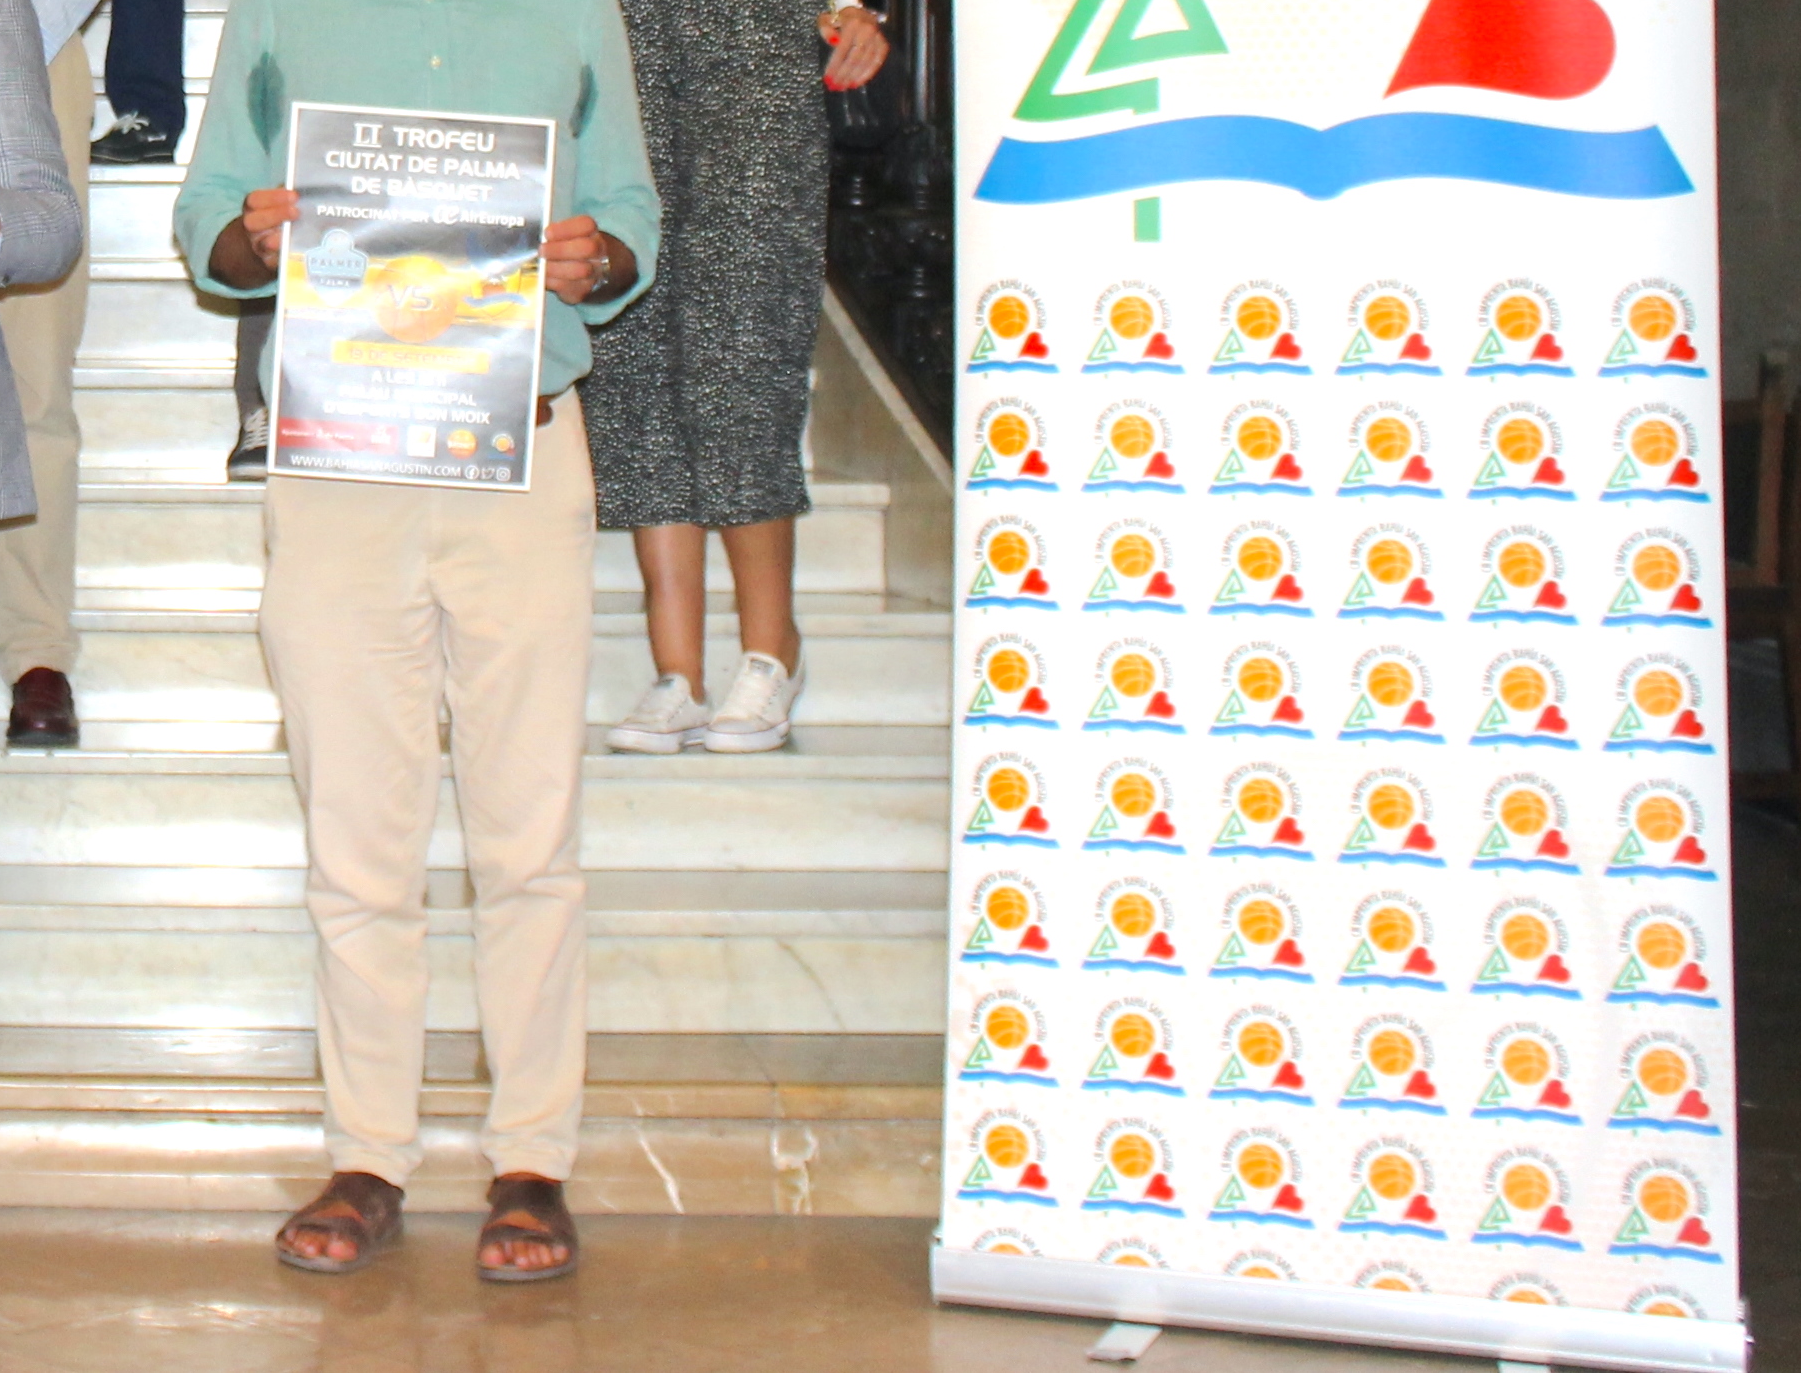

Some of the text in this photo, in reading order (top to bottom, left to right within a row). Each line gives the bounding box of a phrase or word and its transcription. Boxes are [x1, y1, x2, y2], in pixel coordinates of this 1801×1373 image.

[391, 125, 496, 153] TROFEU
[324, 148, 521, 181] CIUTAT DE PALMA
[349, 175, 381, 195] DE
[316, 202, 397, 222] PATROCINAT
[367, 349, 388, 362] DE
[370, 369, 382, 383] A
[450, 408, 490, 425] MOIX
